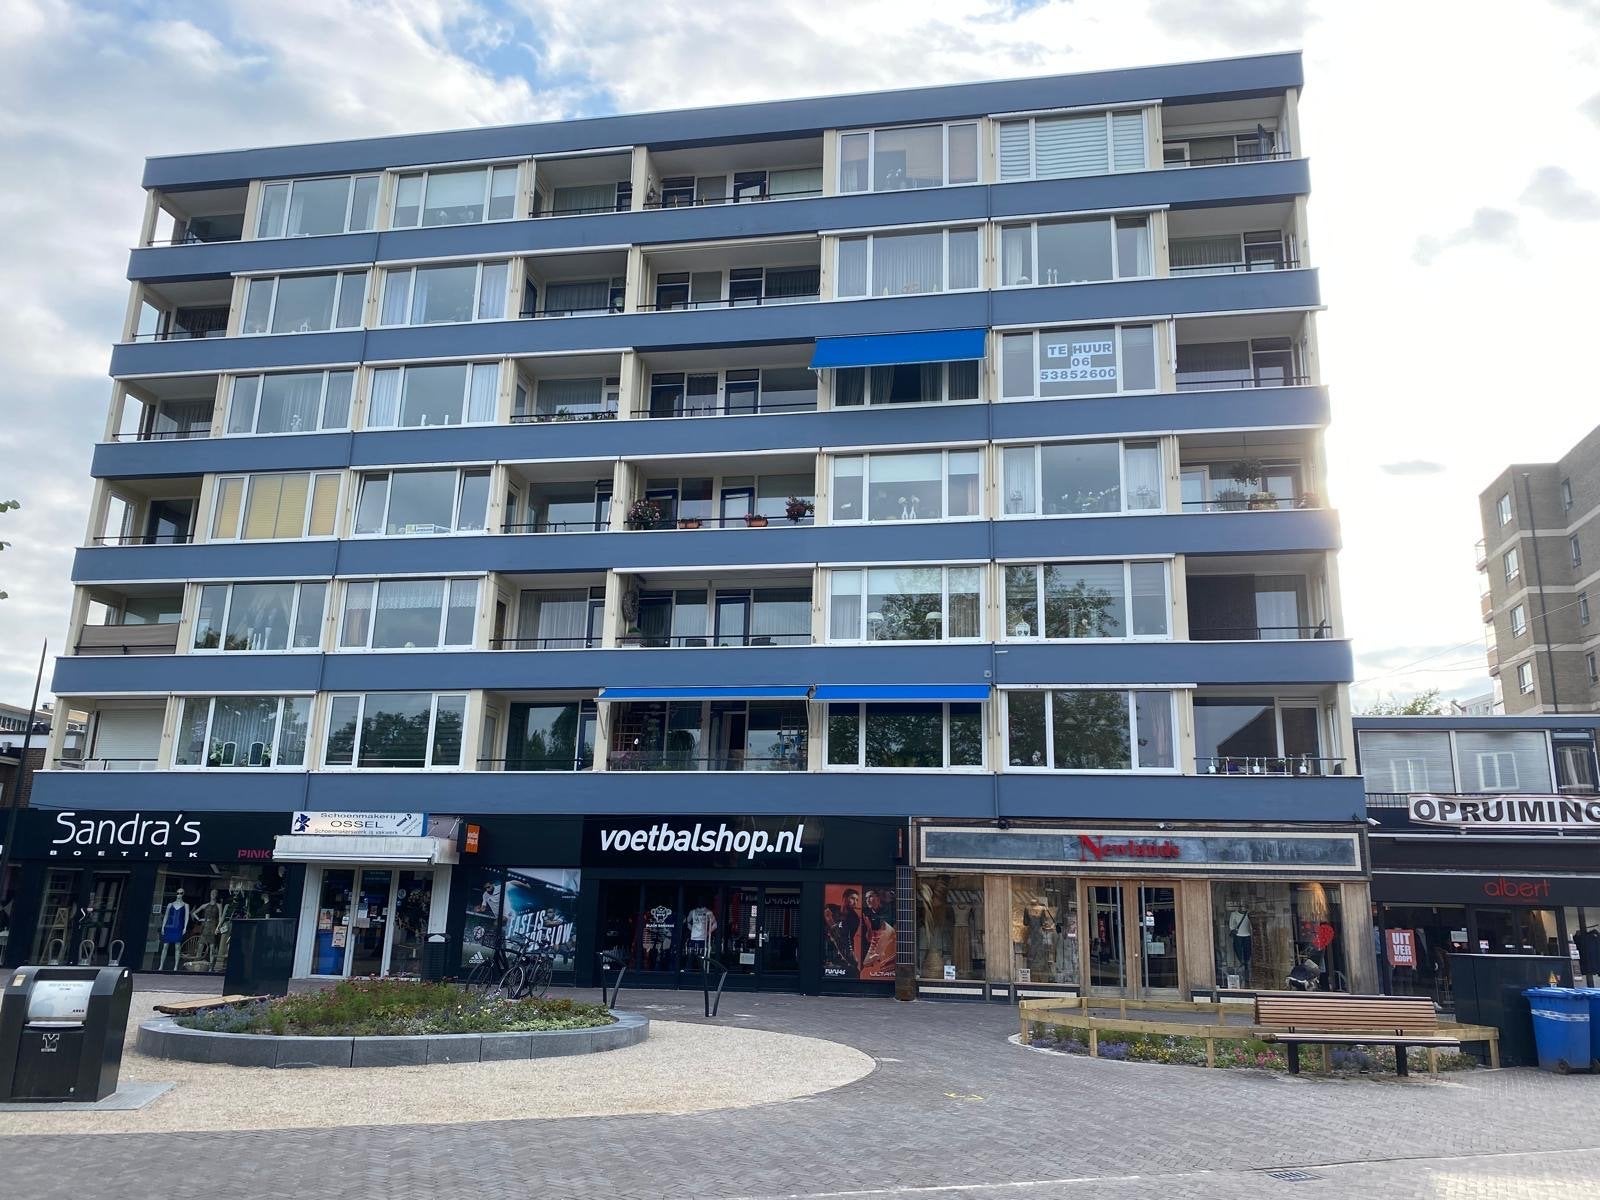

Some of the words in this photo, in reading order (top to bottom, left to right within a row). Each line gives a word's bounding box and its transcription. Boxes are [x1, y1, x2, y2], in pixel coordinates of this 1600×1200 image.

[1049, 346, 1067, 355] TE
[1073, 343, 1112, 354] HUUR
[1072, 357, 1090, 367] 06
[1041, 368, 1116, 380] 53852600
[52, 812, 201, 846] Sandra's
[600, 823, 804, 859] voetbalshop.nl
[1078, 833, 1180, 861] Newlands
[50, 850, 198, 858] BOETIEK
[238, 849, 271, 859] PINK
[1484, 877, 1550, 897] albert
[1391, 932, 1411, 945] UIT
[1393, 944, 1412, 956] VER
